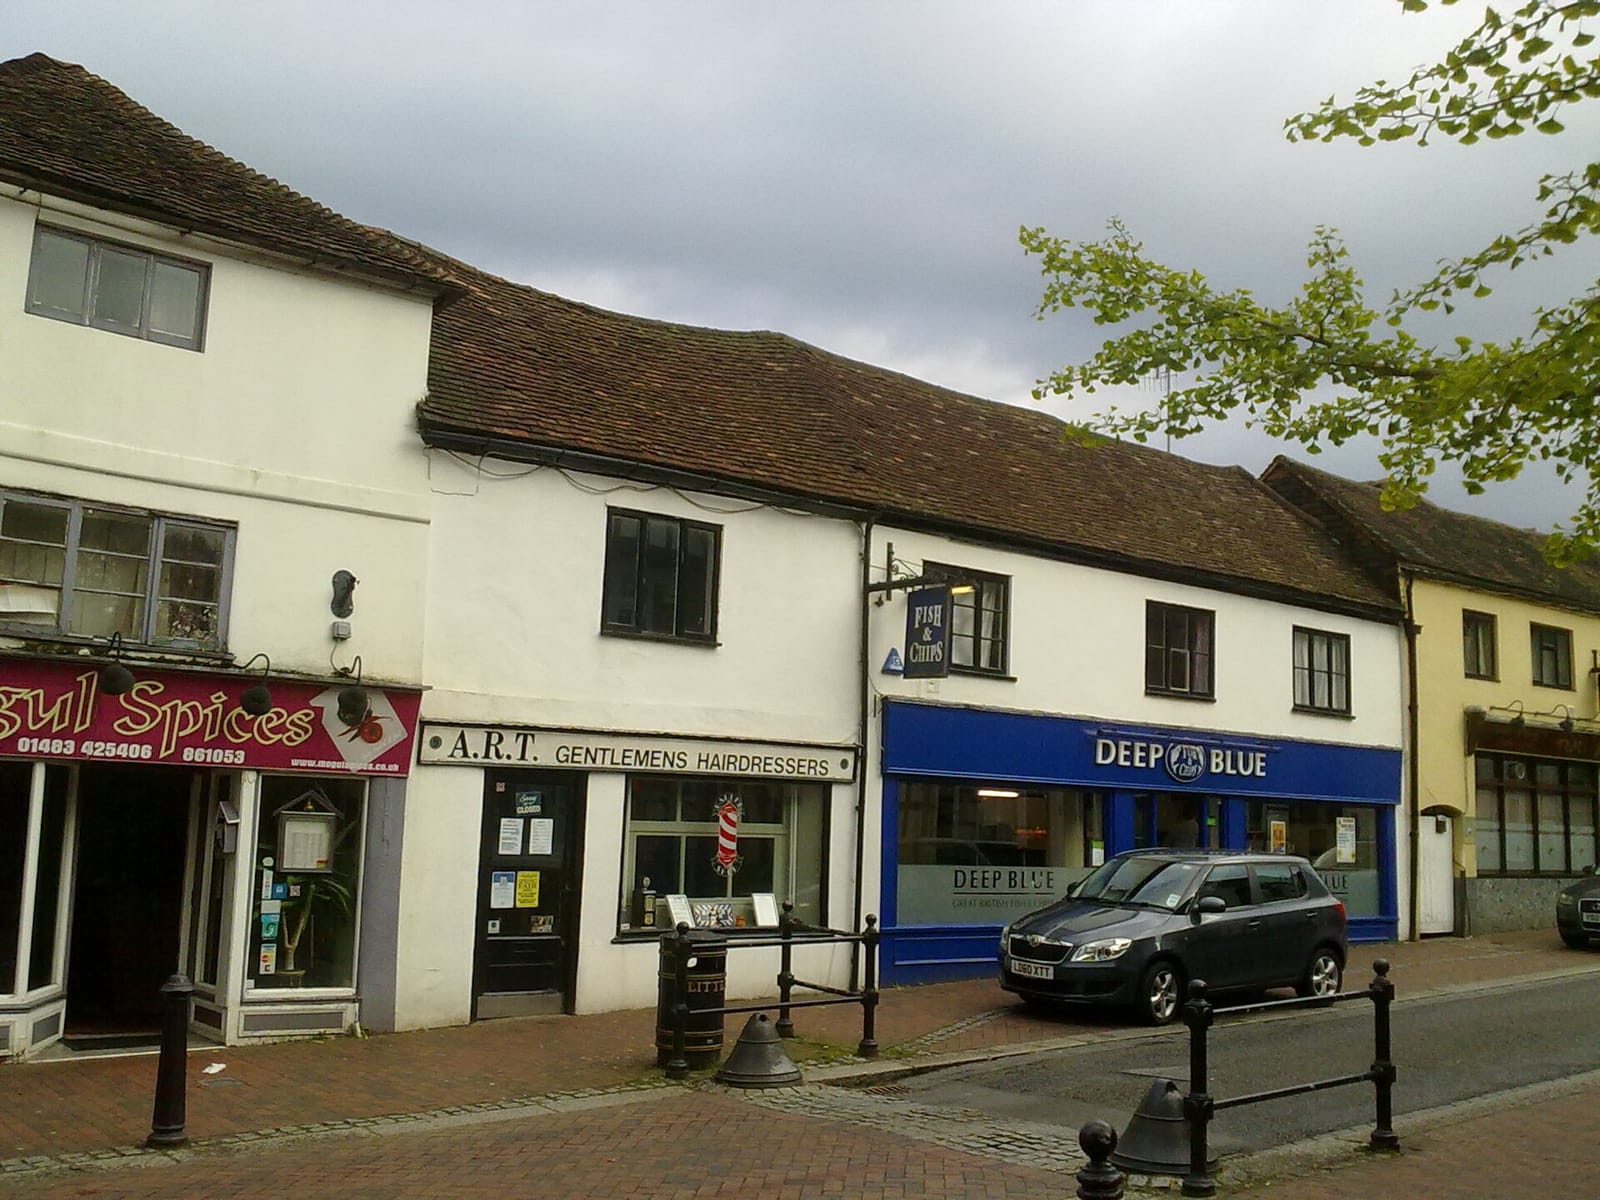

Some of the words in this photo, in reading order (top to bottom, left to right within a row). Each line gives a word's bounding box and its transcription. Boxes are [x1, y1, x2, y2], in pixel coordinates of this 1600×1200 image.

[914, 604, 942, 628] FISH
[922, 626, 933, 642] &
[113, 680, 315, 759] Spices
[17, 737, 75, 755] 01483
[81, 741, 152, 759] 425406
[448, 729, 538, 762] A.R.T.
[555, 745, 688, 769] GENTLEMENS
[697, 752, 829, 776] HAIRDRESSERS
[1095, 739, 1164, 769] DEEP
[1210, 749, 1267, 777] BLUE
[954, 870, 1002, 889] DEEP
[1008, 870, 1054, 889] BLUE
[1318, 872, 1348, 889] LUE
